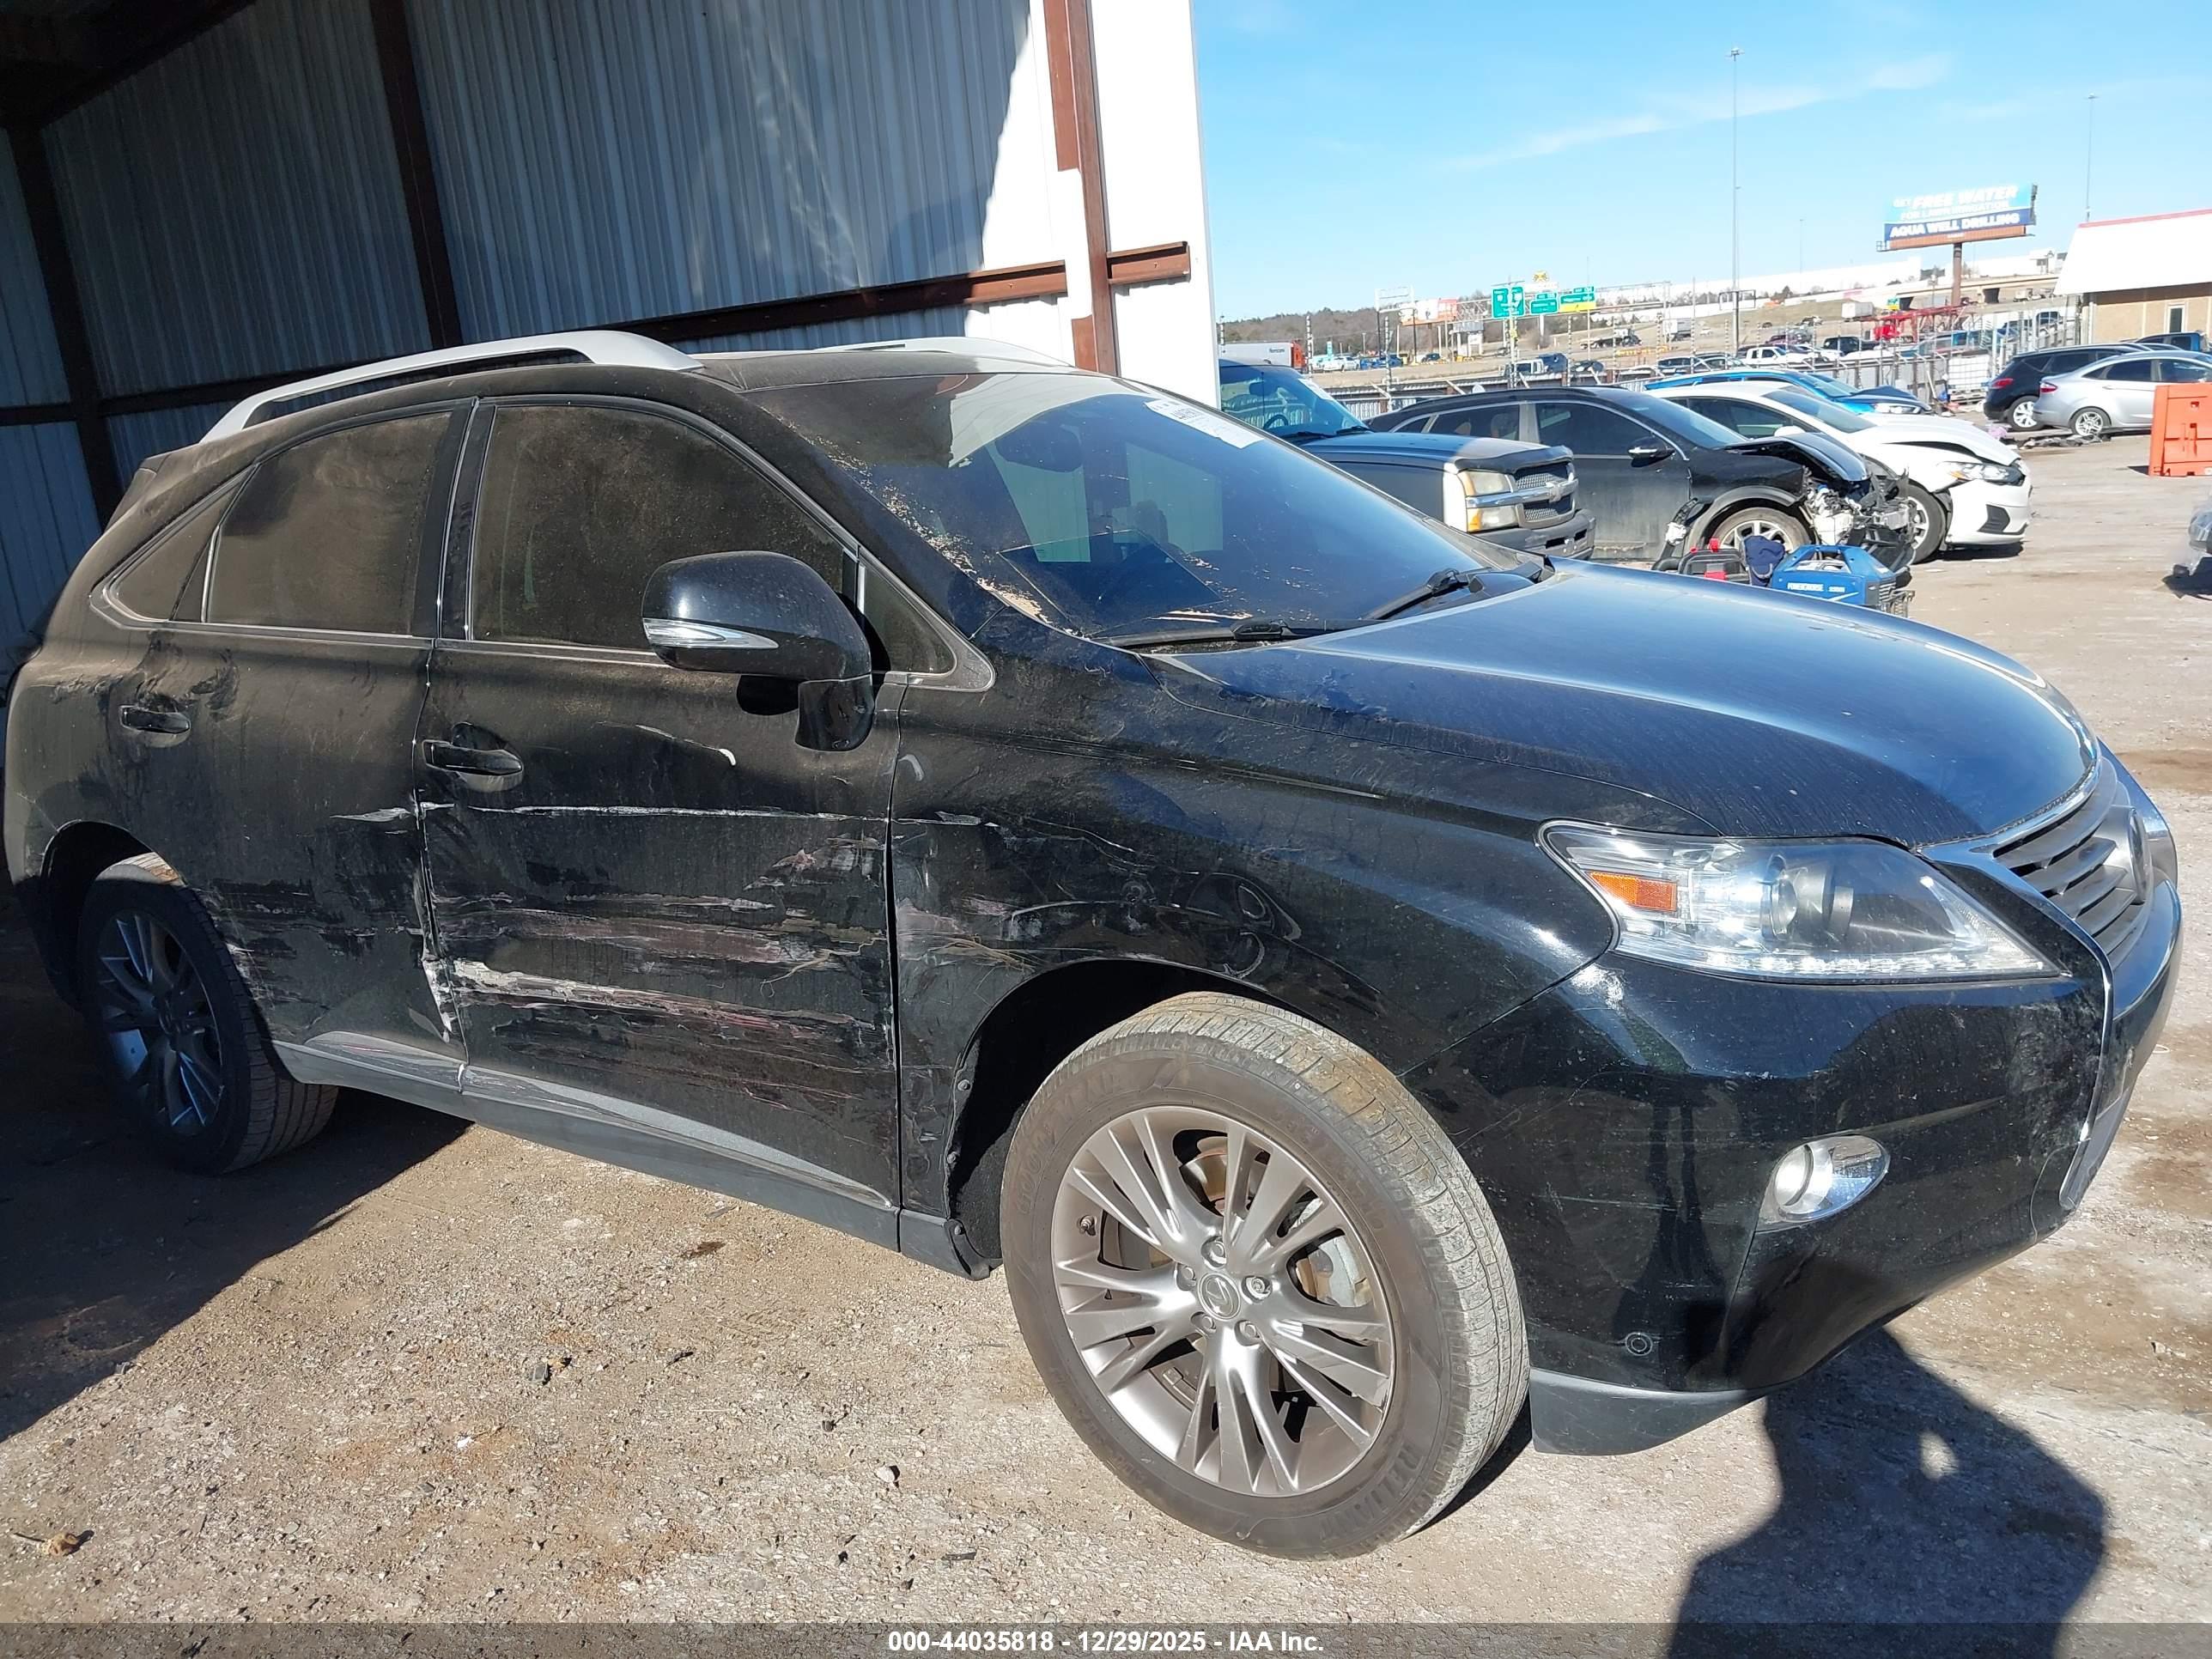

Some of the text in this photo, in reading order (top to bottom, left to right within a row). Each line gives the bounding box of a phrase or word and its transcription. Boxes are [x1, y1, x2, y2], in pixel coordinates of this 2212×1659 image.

[1958, 185, 2017, 204] WATER
[1890, 213, 2021, 237] AQUA WELL DRILLING
